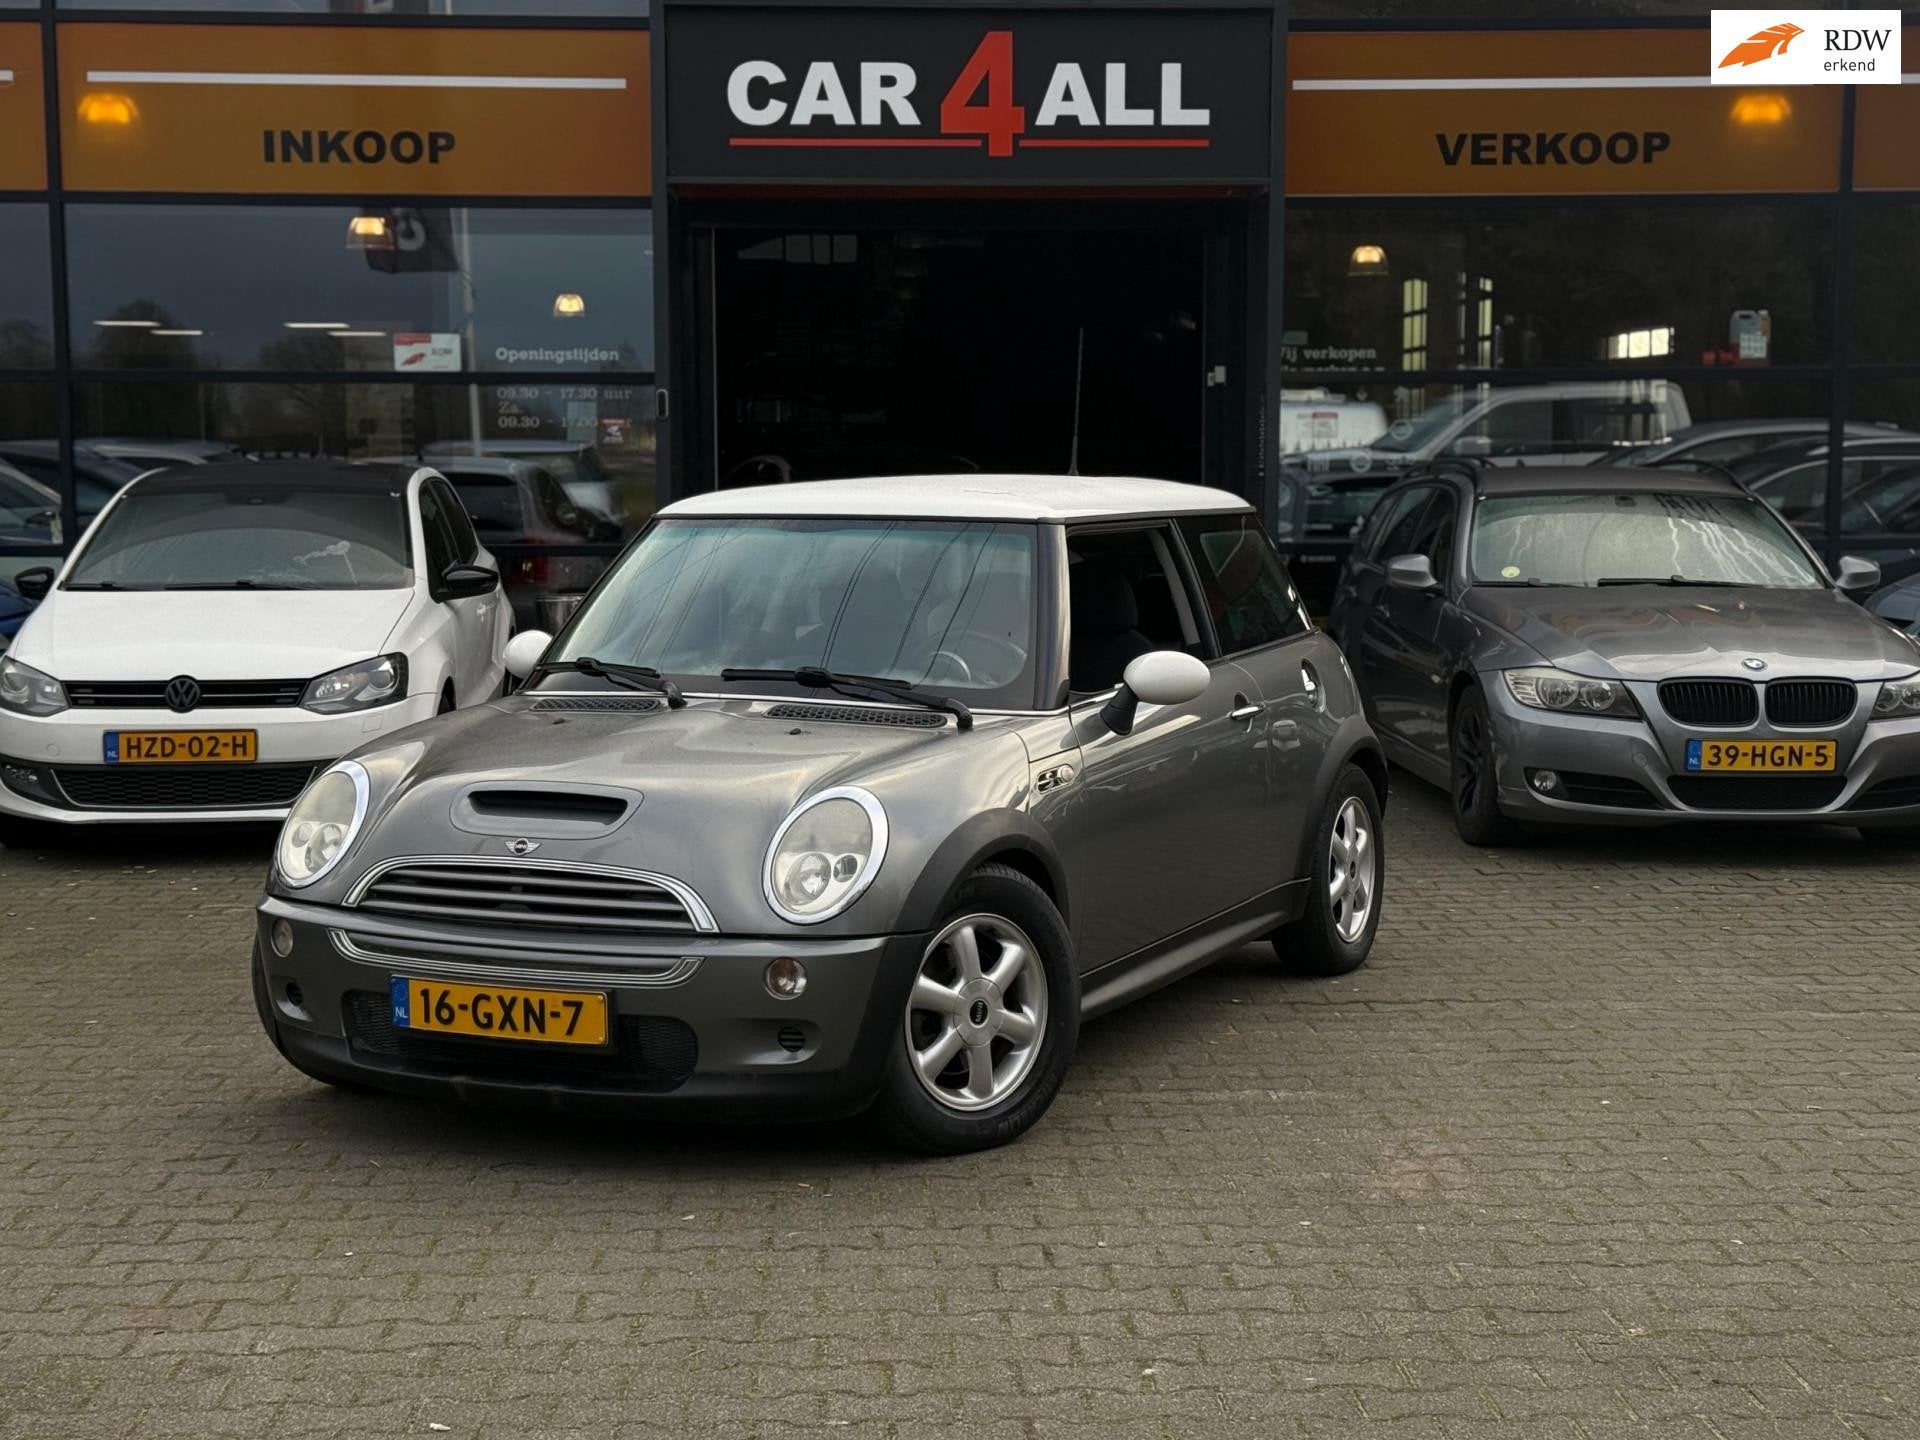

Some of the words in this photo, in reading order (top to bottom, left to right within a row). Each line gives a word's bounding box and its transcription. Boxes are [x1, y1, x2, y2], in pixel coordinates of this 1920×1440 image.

[727, 60, 921, 126] CAR
[939, 30, 1026, 157] 4
[1034, 62, 1211, 126] ALL
[263, 129, 456, 164] INKOOP
[1435, 131, 1671, 166] VERKOOP
[495, 346, 620, 364] Openingstijden
[1303, 346, 1377, 362] verkopen
[496, 387, 539, 400] 09.30
[126, 735, 248, 759] HZD-02-H
[1707, 744, 1829, 767] 39-HGN-5
[394, 1006, 409, 1019] NL
[419, 987, 584, 1037] 16-GXN-7
